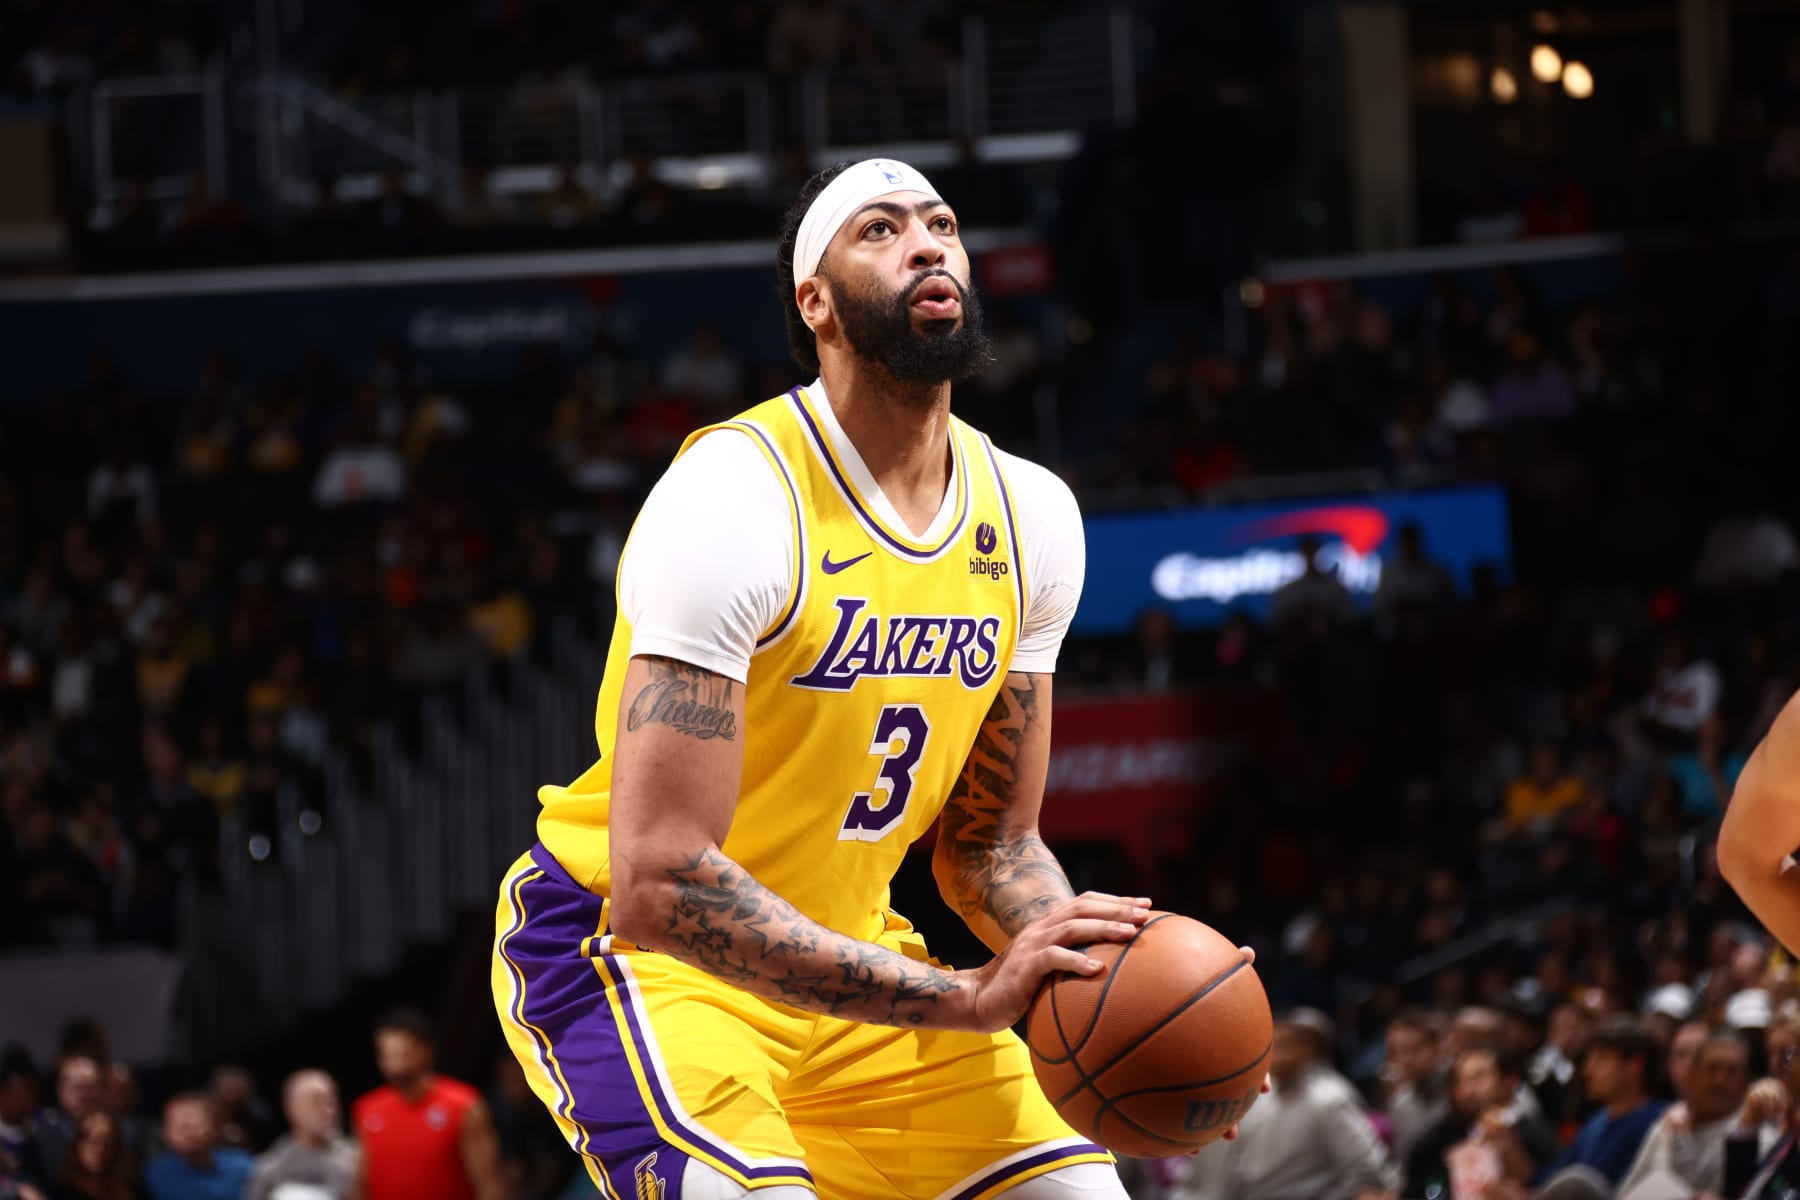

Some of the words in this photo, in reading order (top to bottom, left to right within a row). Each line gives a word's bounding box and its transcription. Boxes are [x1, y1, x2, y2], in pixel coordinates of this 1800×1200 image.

[969, 556, 1009, 581] bibigo
[788, 595, 1000, 692] LAKERS
[837, 703, 932, 843] 3
